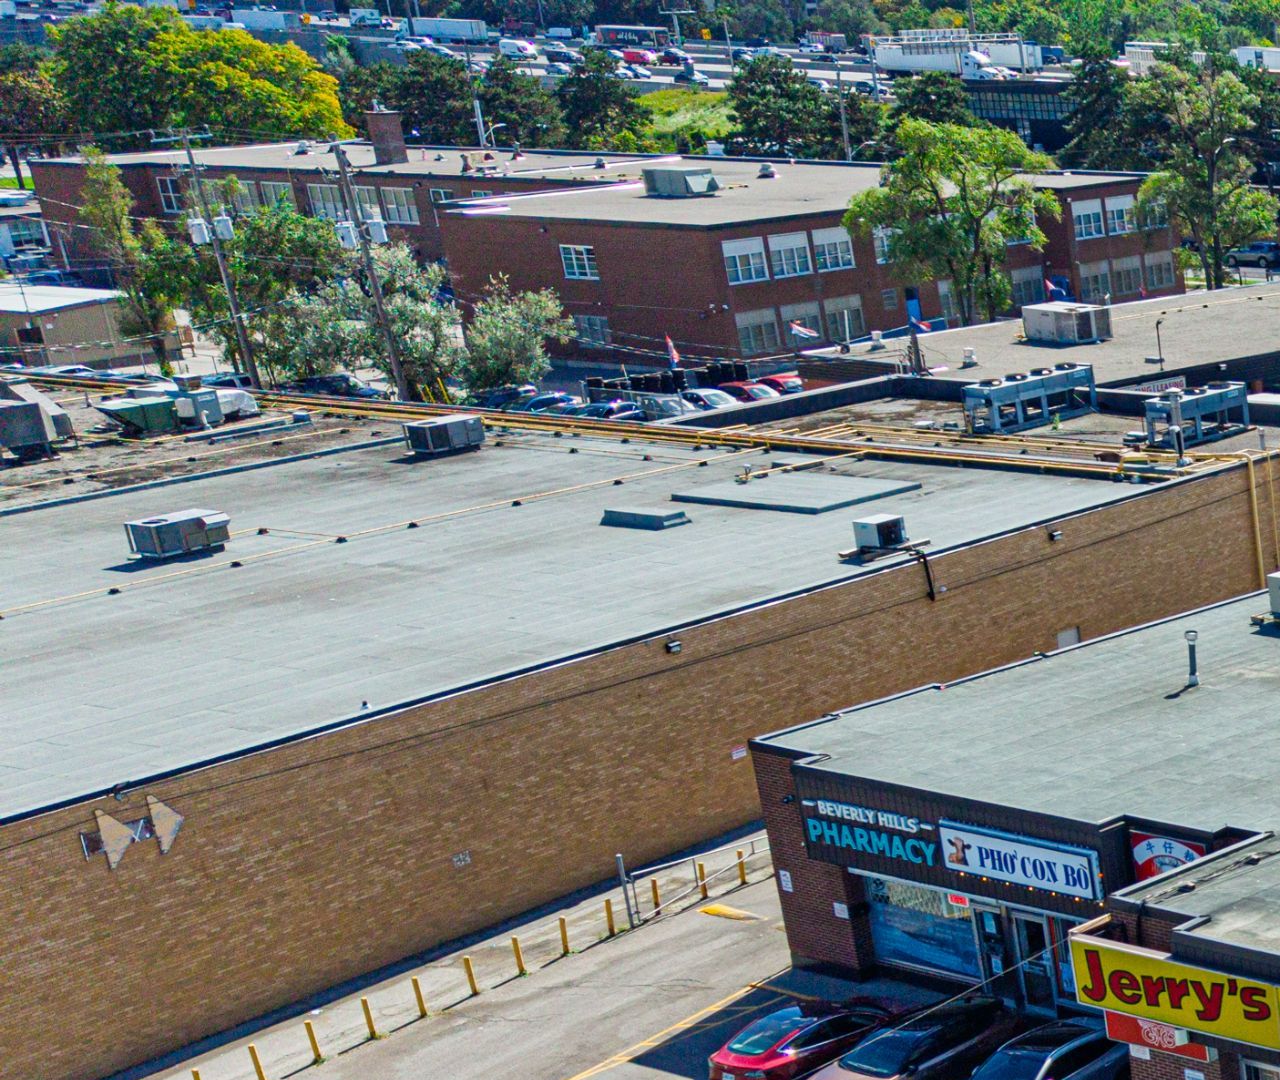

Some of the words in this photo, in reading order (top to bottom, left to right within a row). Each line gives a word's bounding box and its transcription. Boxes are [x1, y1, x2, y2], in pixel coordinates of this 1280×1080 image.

[817, 800, 875, 824] BEVERLY
[877, 812, 918, 833] HILLS
[807, 818, 936, 867] PHARMACY
[1020, 856, 1058, 883] CON
[1081, 949, 1271, 1022] Jerry's
